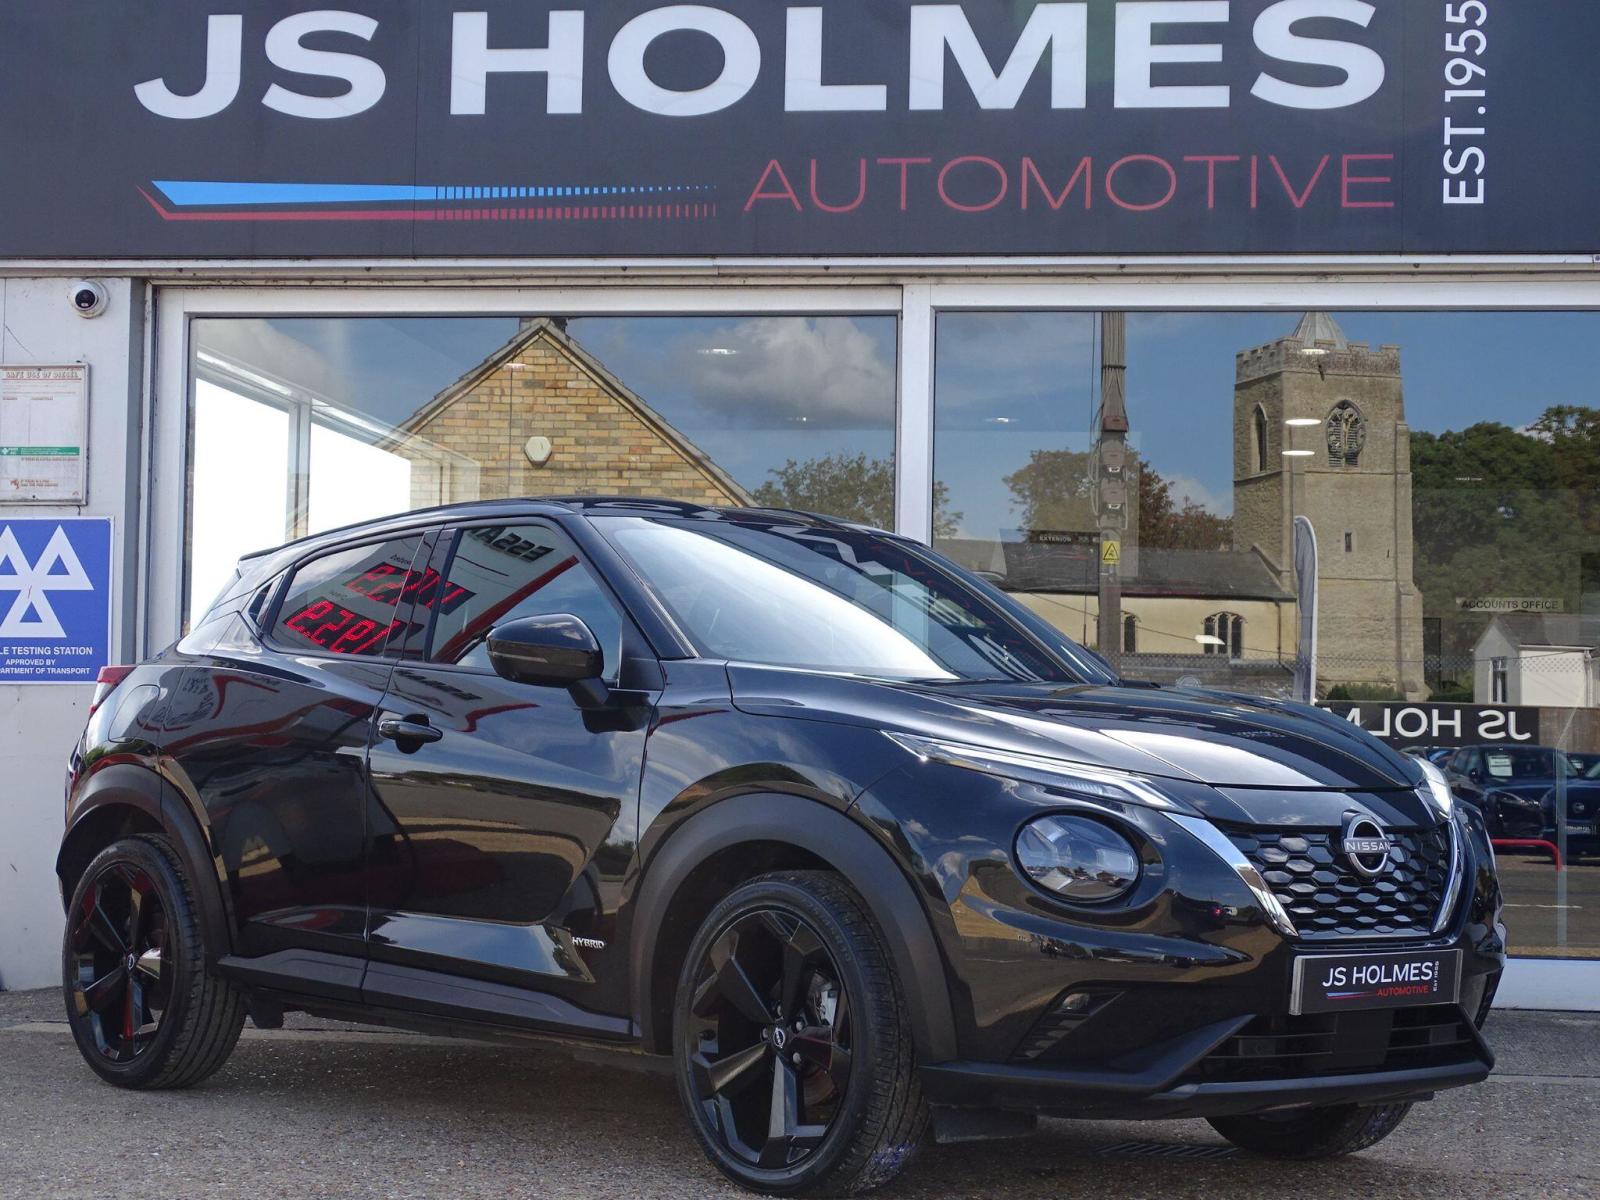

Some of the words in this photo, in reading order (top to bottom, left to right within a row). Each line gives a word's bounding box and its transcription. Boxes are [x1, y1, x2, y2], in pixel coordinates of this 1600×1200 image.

[134, 10, 387, 119] JS
[449, 0, 1386, 117] HOLMES
[1443, 0, 1487, 204] EST.1955
[744, 153, 1395, 213] AUTOMOTIVE
[1461, 600, 1519, 609] ACCOUNTS
[1521, 600, 1559, 609] OFFICE
[11, 646, 52, 655] TESTING
[53, 646, 93, 655] STATION
[1346, 841, 1391, 851] NISSAN
[571, 936, 605, 949] HYBRID
[1322, 967, 1347, 987] JS
[1352, 962, 1433, 985] HOLMES
[1376, 985, 1429, 997] AUTOMOTIVE
